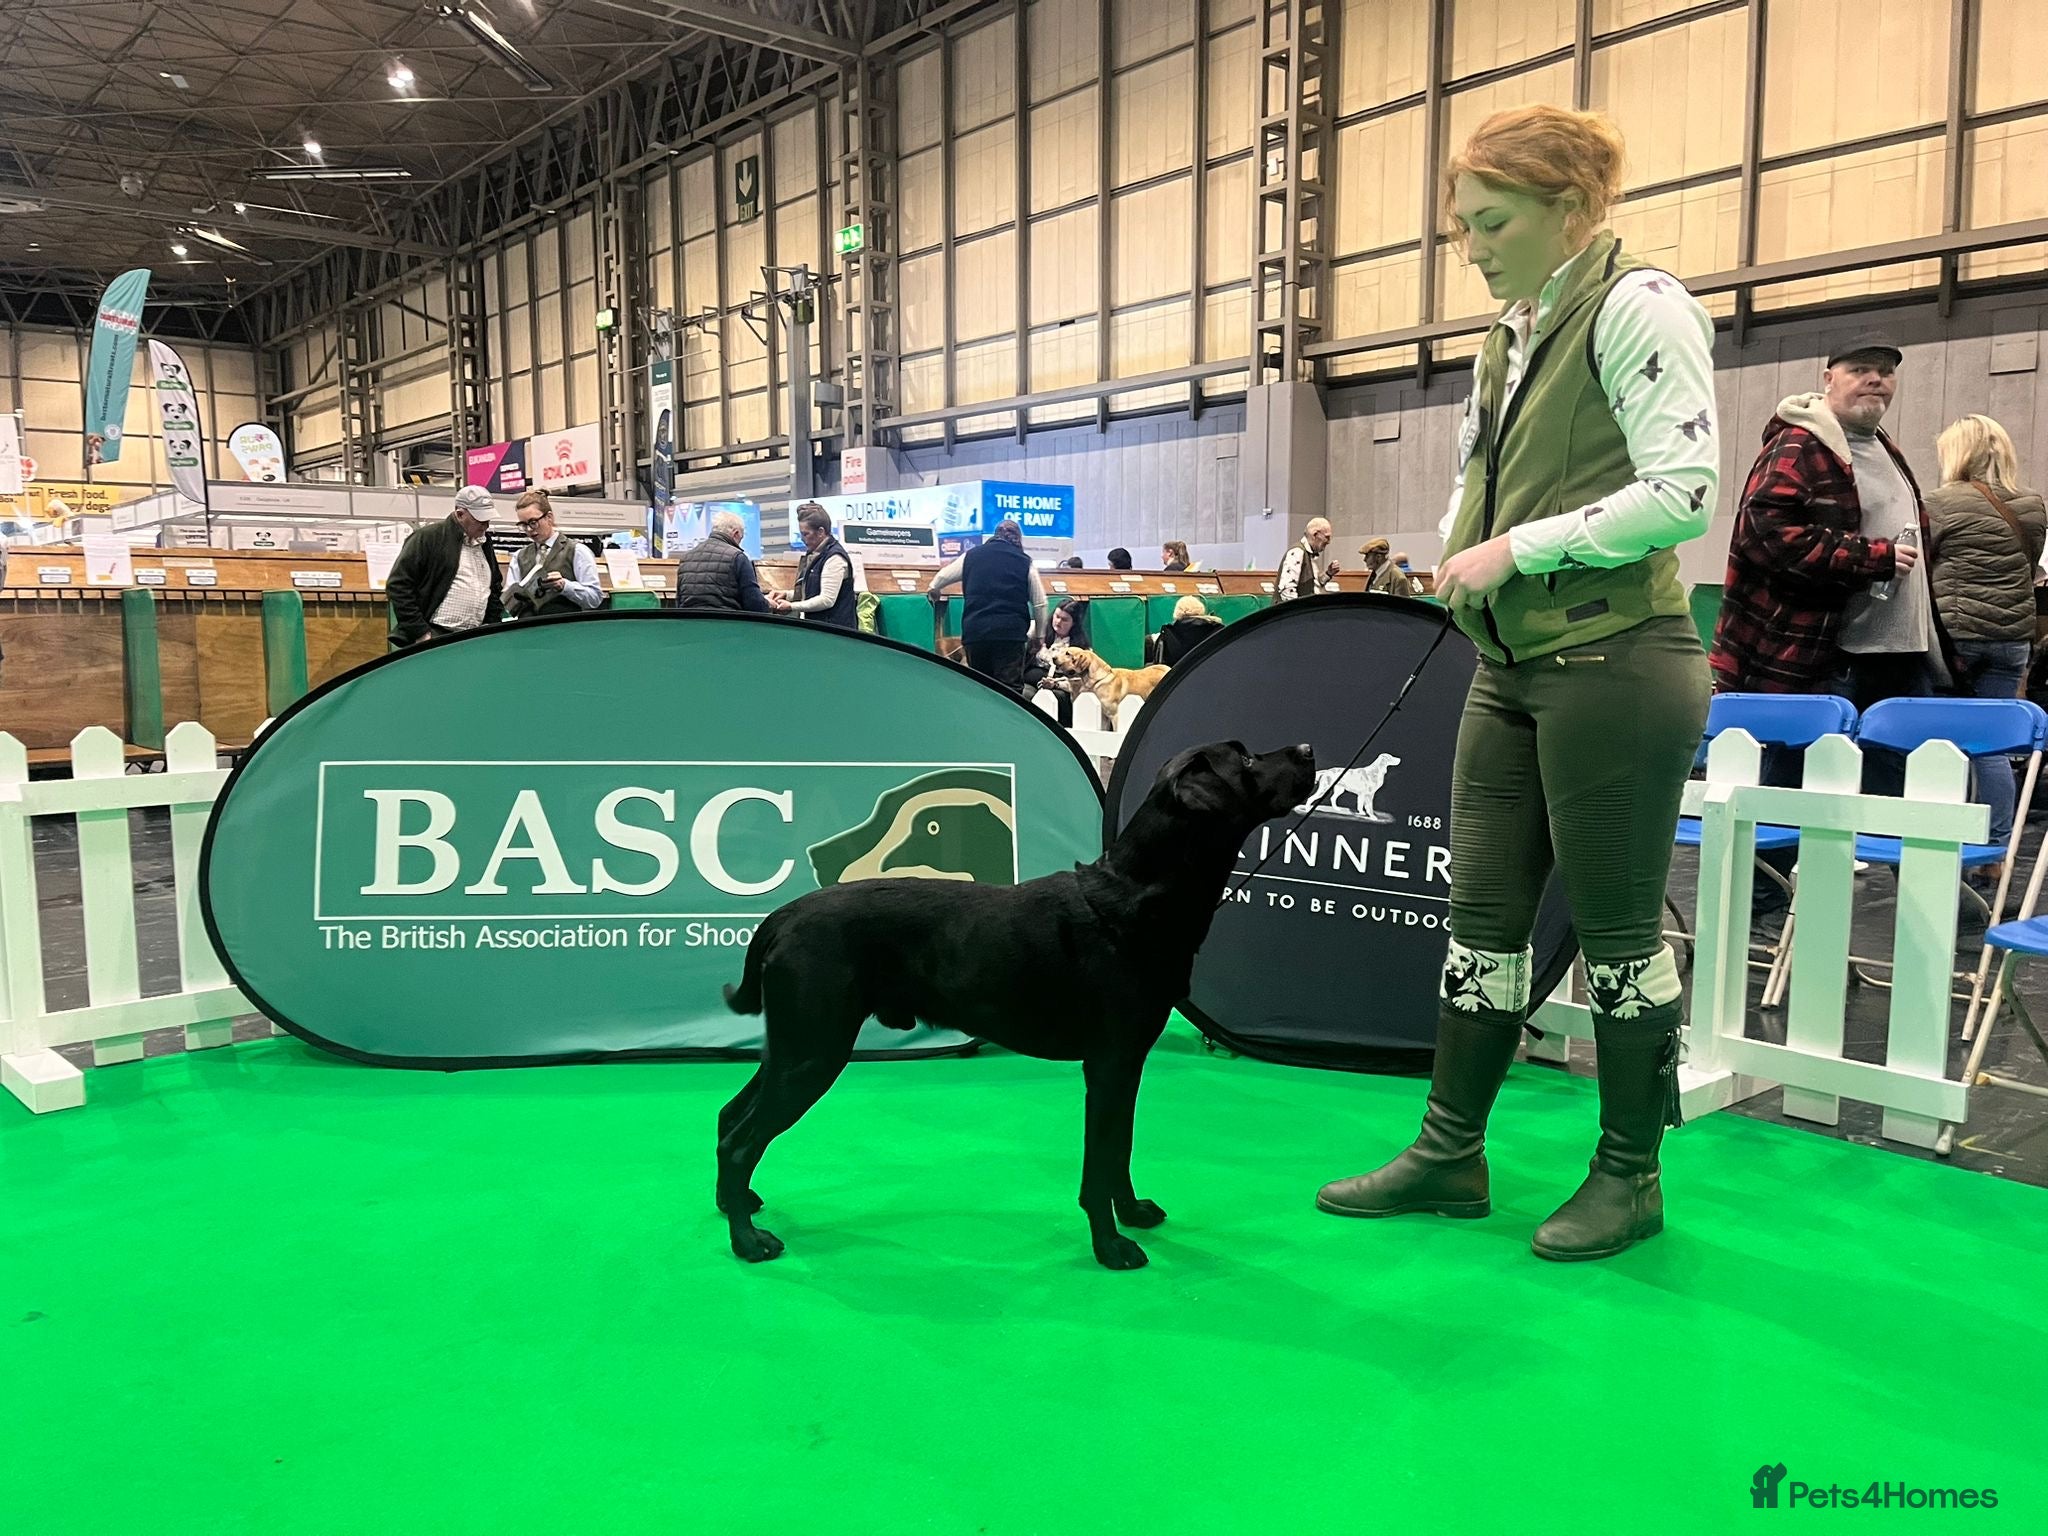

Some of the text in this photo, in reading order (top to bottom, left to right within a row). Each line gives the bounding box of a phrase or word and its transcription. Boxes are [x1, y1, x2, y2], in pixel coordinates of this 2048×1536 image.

[740, 203, 753, 221] EXIT
[845, 456, 861, 468] Fire
[543, 465, 564, 480] ROYAL
[844, 473, 865, 485] point
[48, 488, 78, 499] Fresh
[86, 501, 111, 513] dogs
[994, 494, 1062, 511] THE HOME
[1003, 512, 1055, 527] OF RAW
[866, 528, 912, 538] Gamekeepers
[1407, 815, 1442, 830] 1688
[360, 786, 795, 896] BASC
[1238, 826, 1452, 885] INNER
[1266, 892, 1295, 909] TO
[1310, 898, 1336, 915] BE
[319, 926, 371, 949] The
[382, 924, 466, 949] British
[475, 924, 627, 948] Association
[638, 923, 676, 947] for
